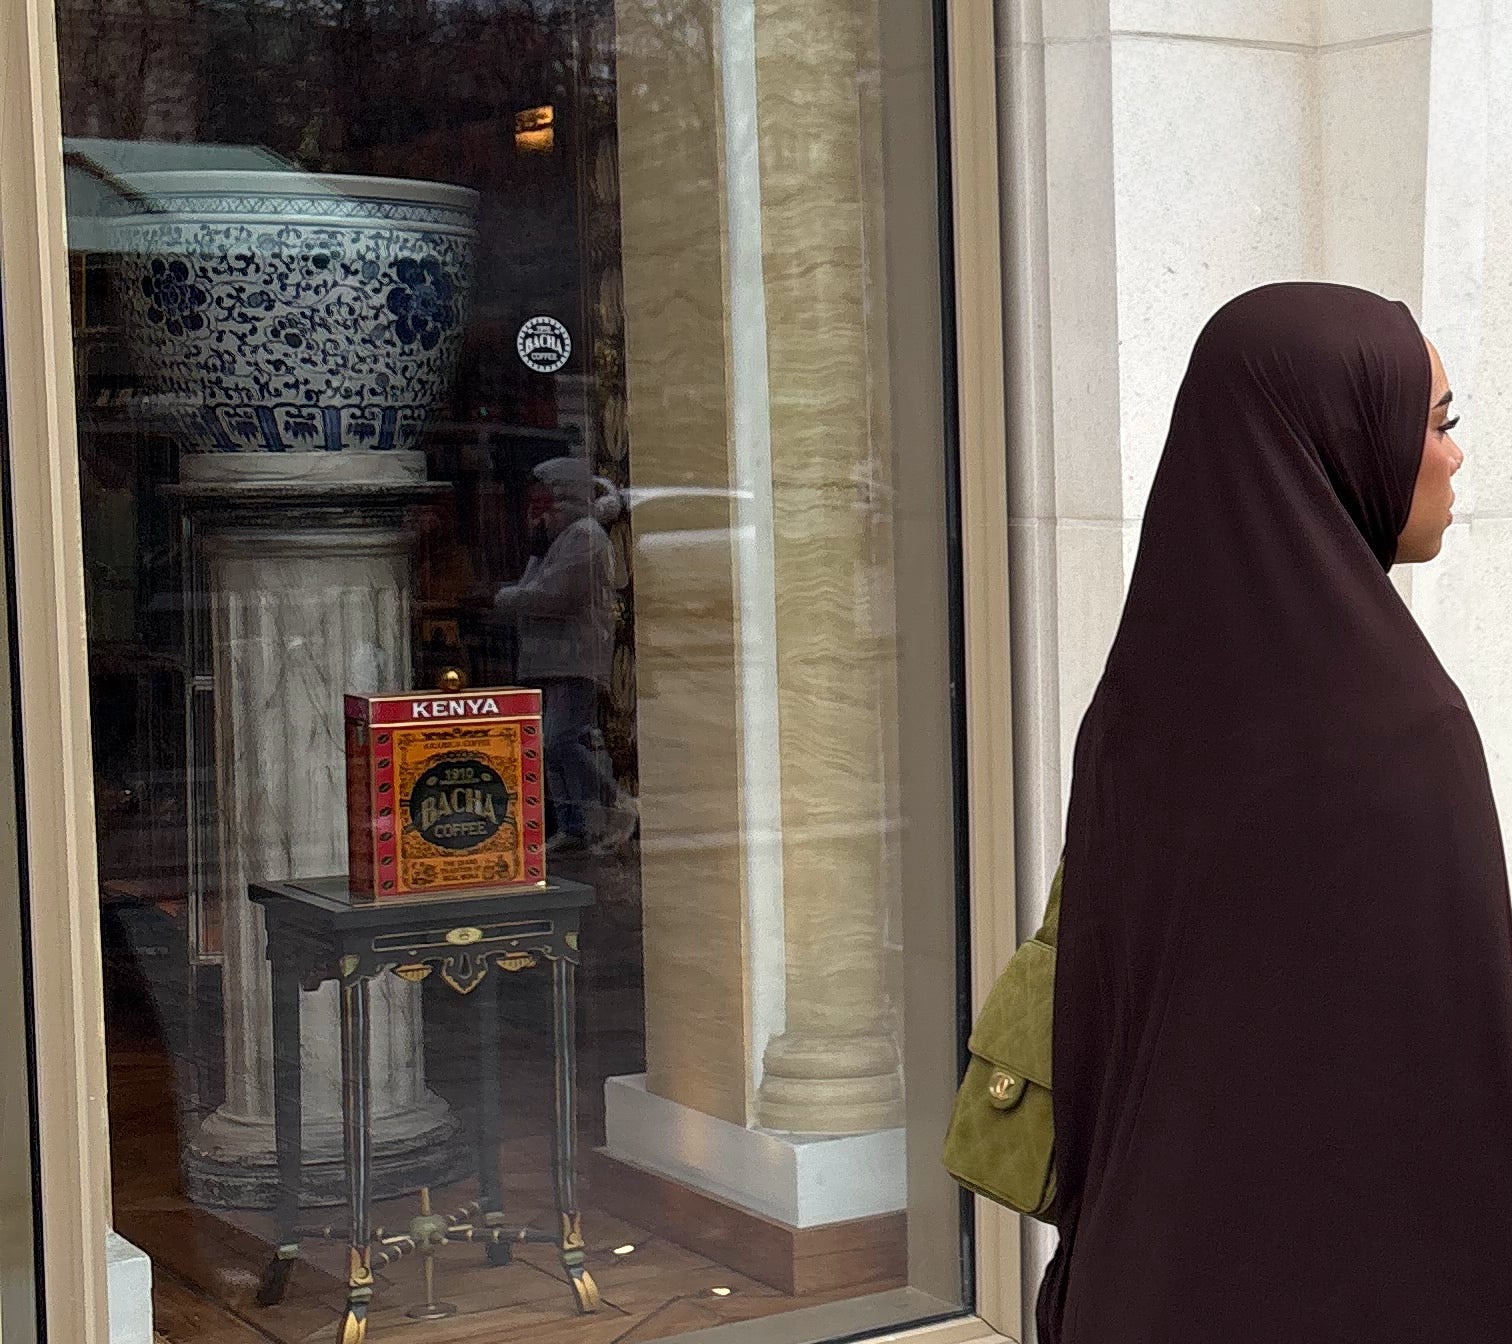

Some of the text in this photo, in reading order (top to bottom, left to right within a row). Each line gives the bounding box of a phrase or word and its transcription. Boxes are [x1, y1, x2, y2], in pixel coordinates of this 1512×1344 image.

[525, 334, 563, 354] BACHA
[412, 698, 499, 718] KENYA
[444, 767, 474, 779] 1910
[421, 788, 499, 831] BACHA
[434, 821, 488, 838] COFFEE
